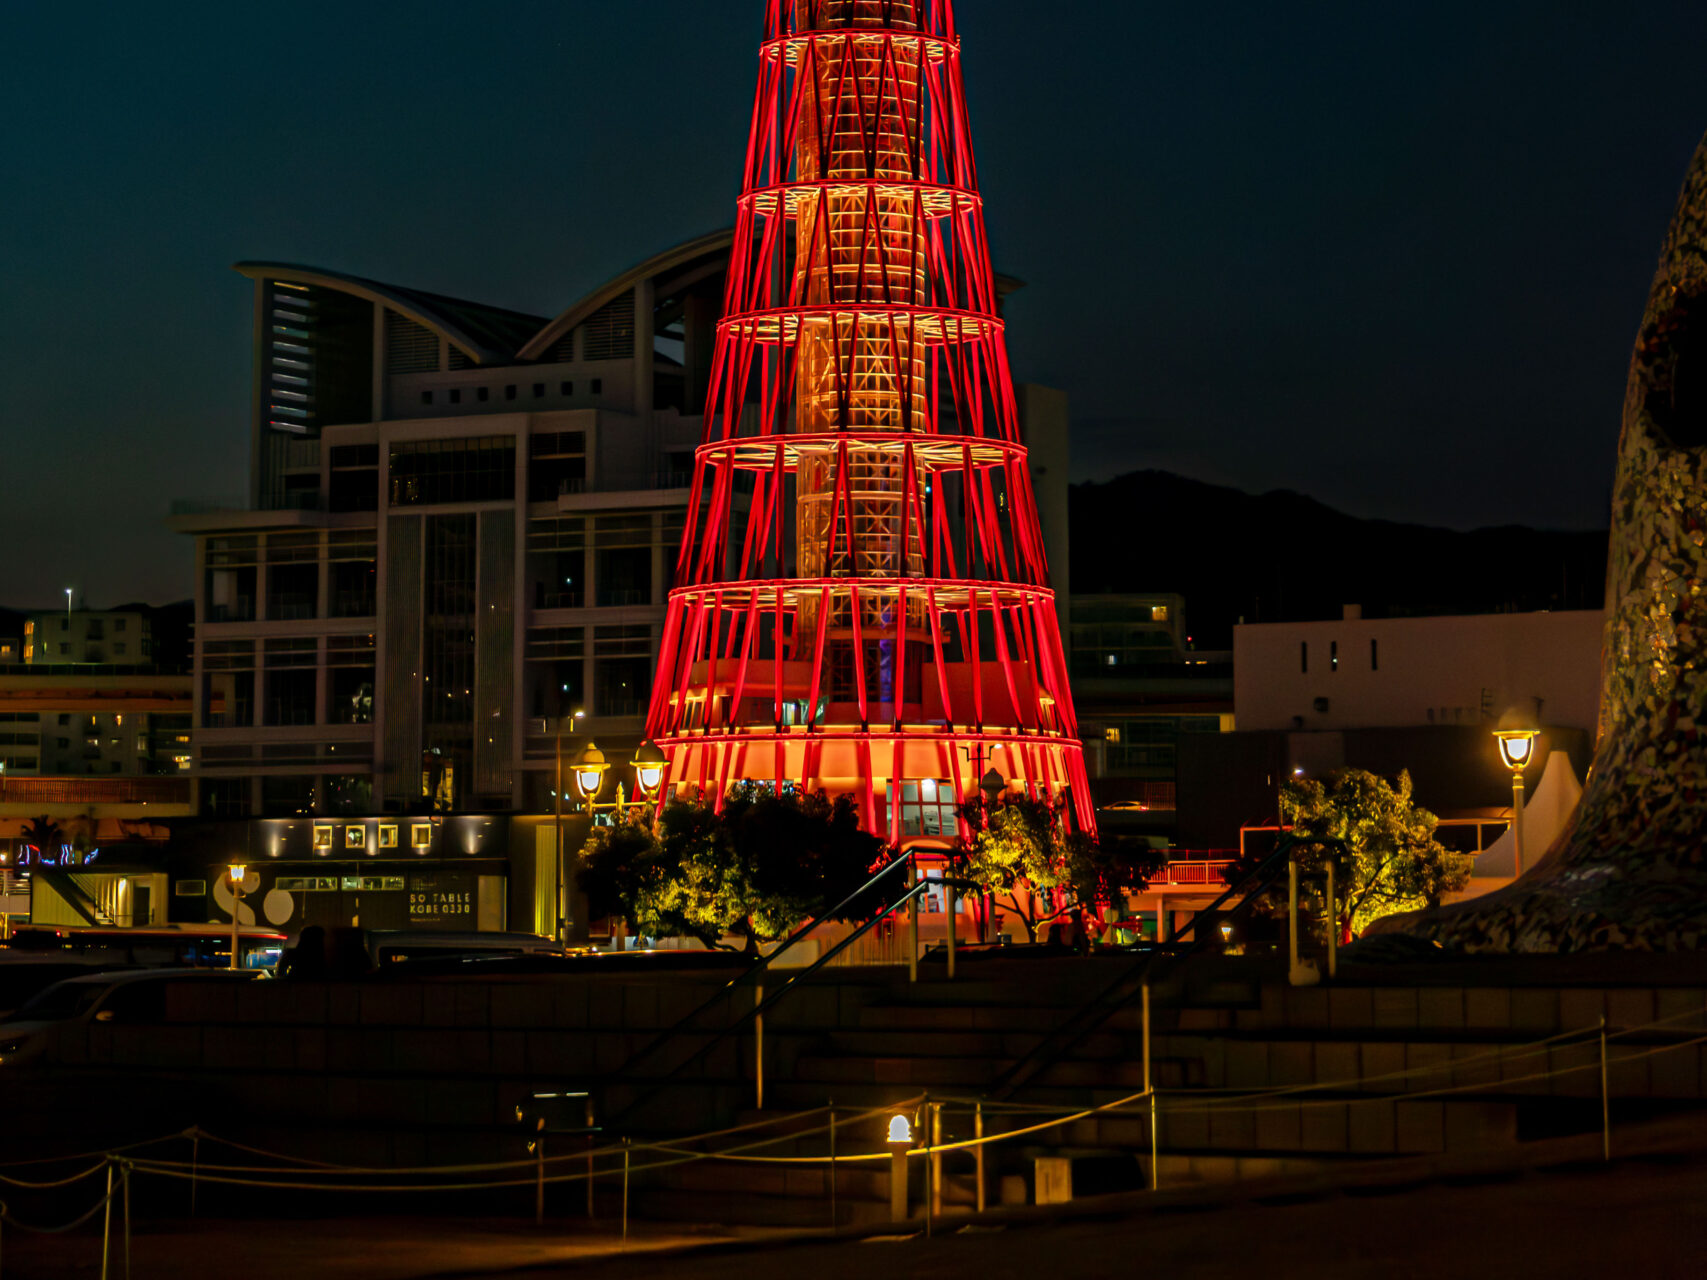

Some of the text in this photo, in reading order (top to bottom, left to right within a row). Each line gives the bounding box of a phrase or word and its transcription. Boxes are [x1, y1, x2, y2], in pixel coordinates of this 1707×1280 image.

[410, 892, 471, 903] SO TABLE
[410, 904, 439, 914] KOBE
